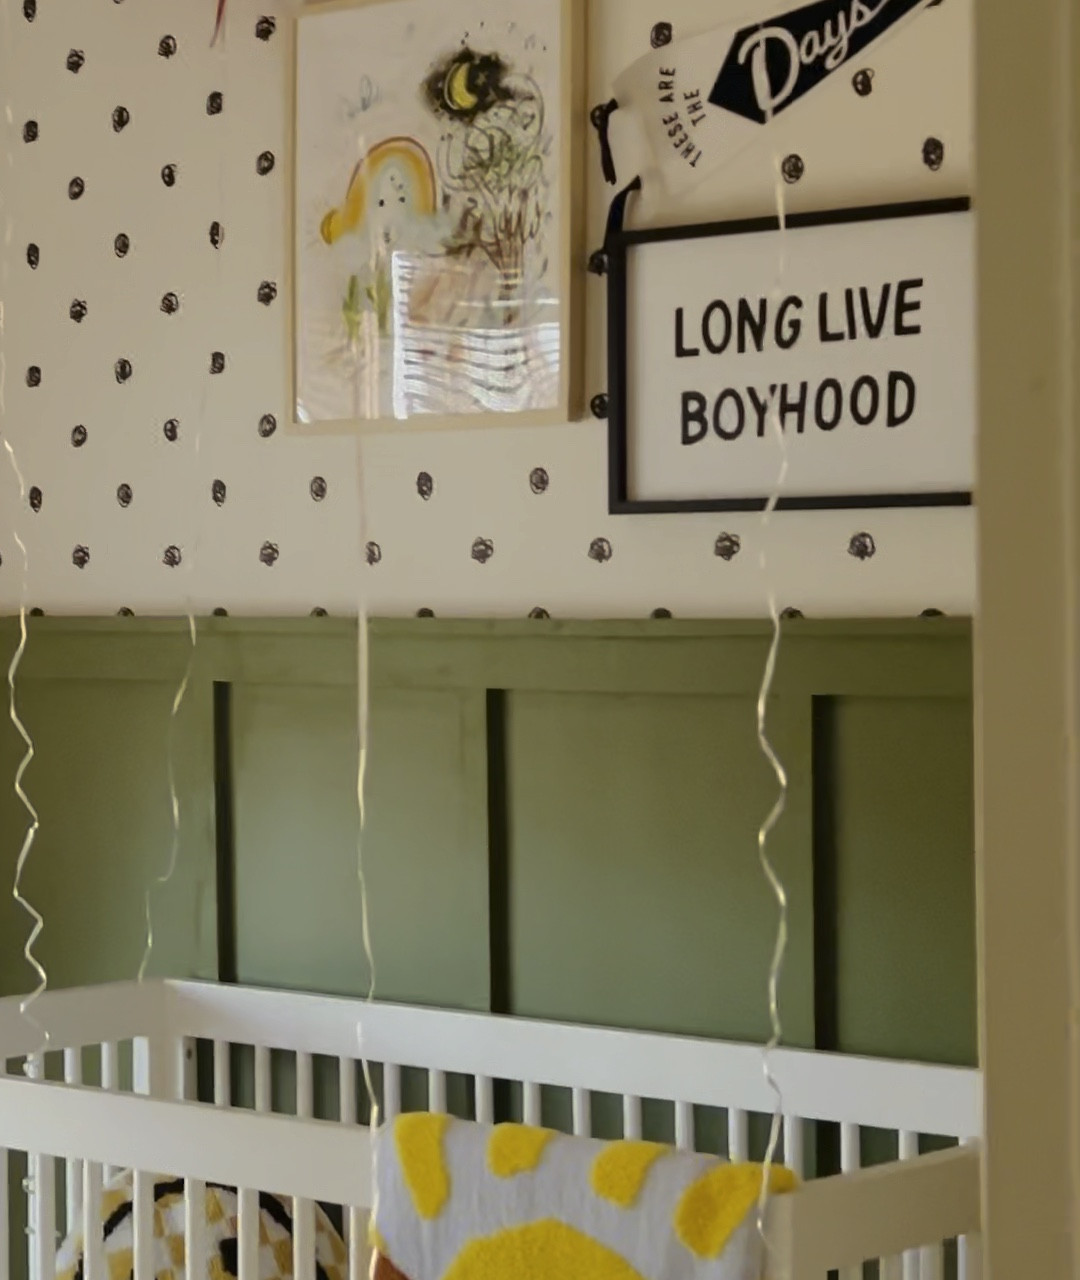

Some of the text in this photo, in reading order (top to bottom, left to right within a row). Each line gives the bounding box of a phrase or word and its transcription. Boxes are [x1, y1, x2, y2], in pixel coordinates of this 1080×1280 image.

[657, 66, 703, 168] THESE ARE
[682, 88, 707, 127] THE
[673, 277, 924, 358] LONG LIVE
[680, 369, 917, 446] BOYHOOD
